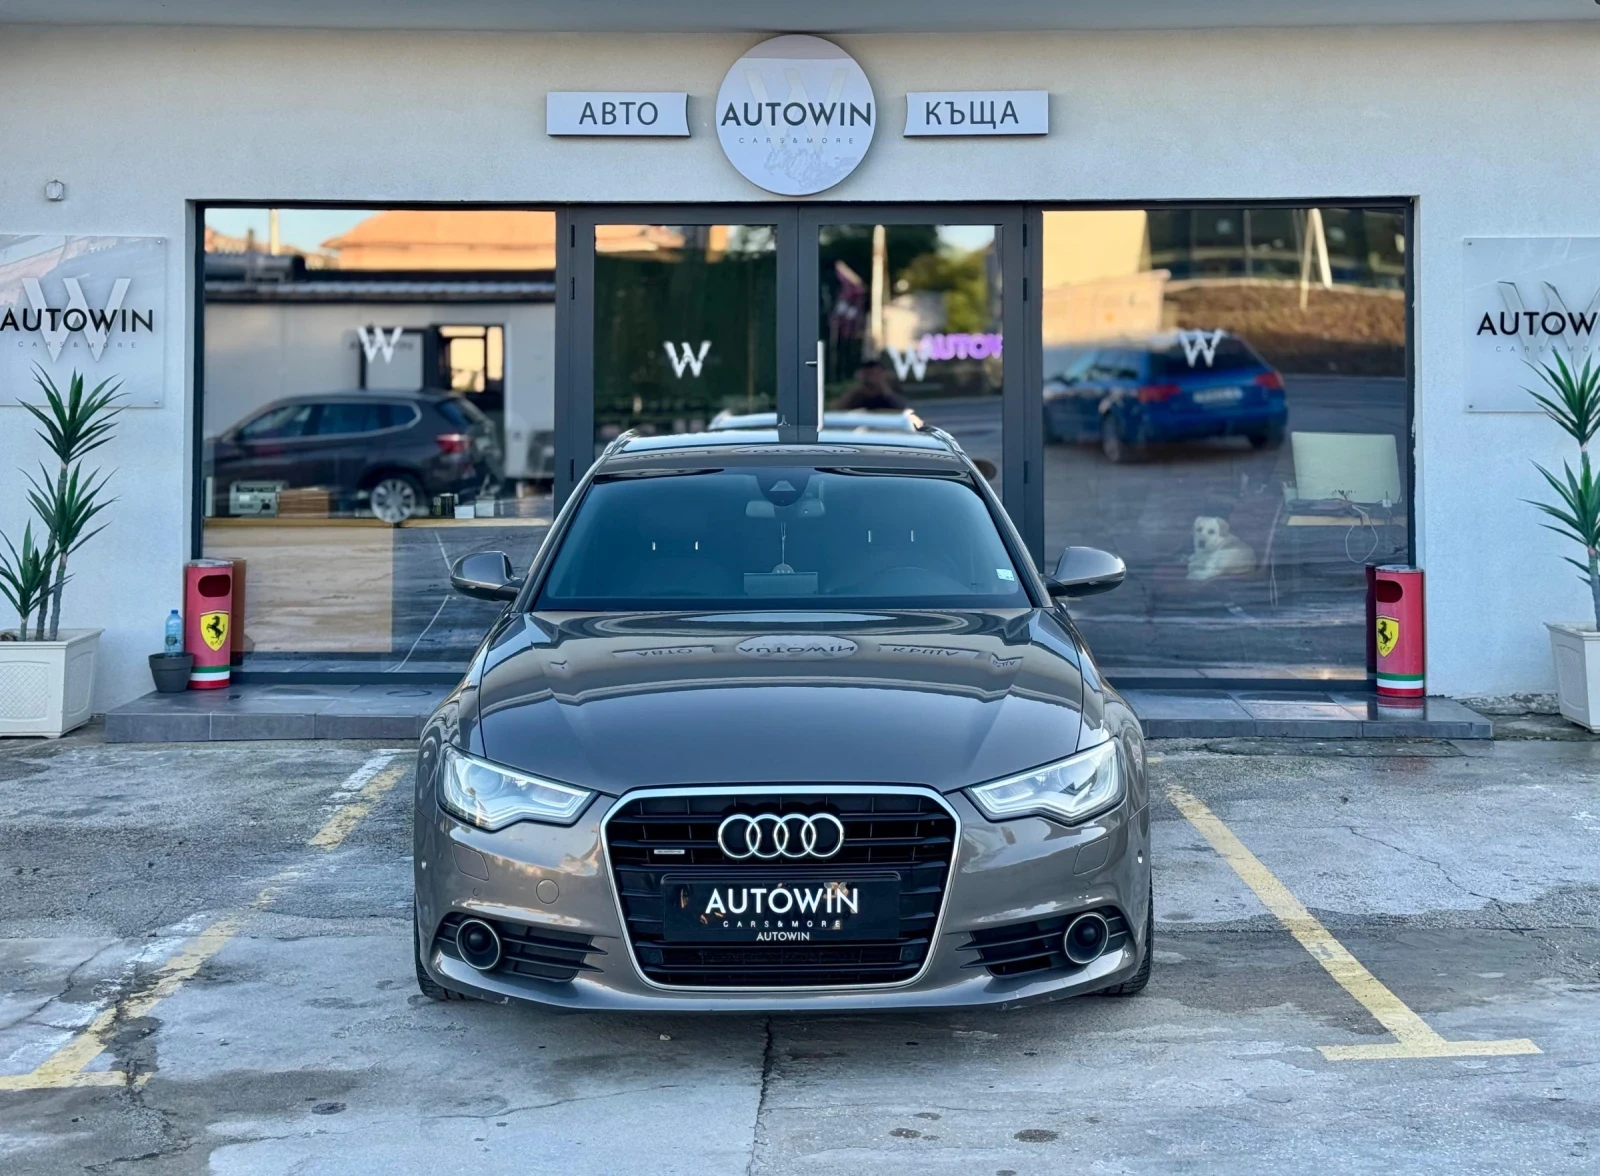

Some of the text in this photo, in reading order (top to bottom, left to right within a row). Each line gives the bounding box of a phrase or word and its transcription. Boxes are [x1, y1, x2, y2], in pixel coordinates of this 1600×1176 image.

[579, 101, 659, 126] АВТО
[720, 102, 872, 126] AUTOWIN
[924, 100, 1019, 129] КЪЩА
[0, 307, 153, 333] AUTOWIN
[1476, 312, 1598, 336] AUTOW
[358, 326, 402, 364] W
[1178, 328, 1223, 367] W
[664, 340, 712, 378] W
[705, 888, 859, 914] AUTOWIN
[756, 931, 811, 942] AUTOWIN
